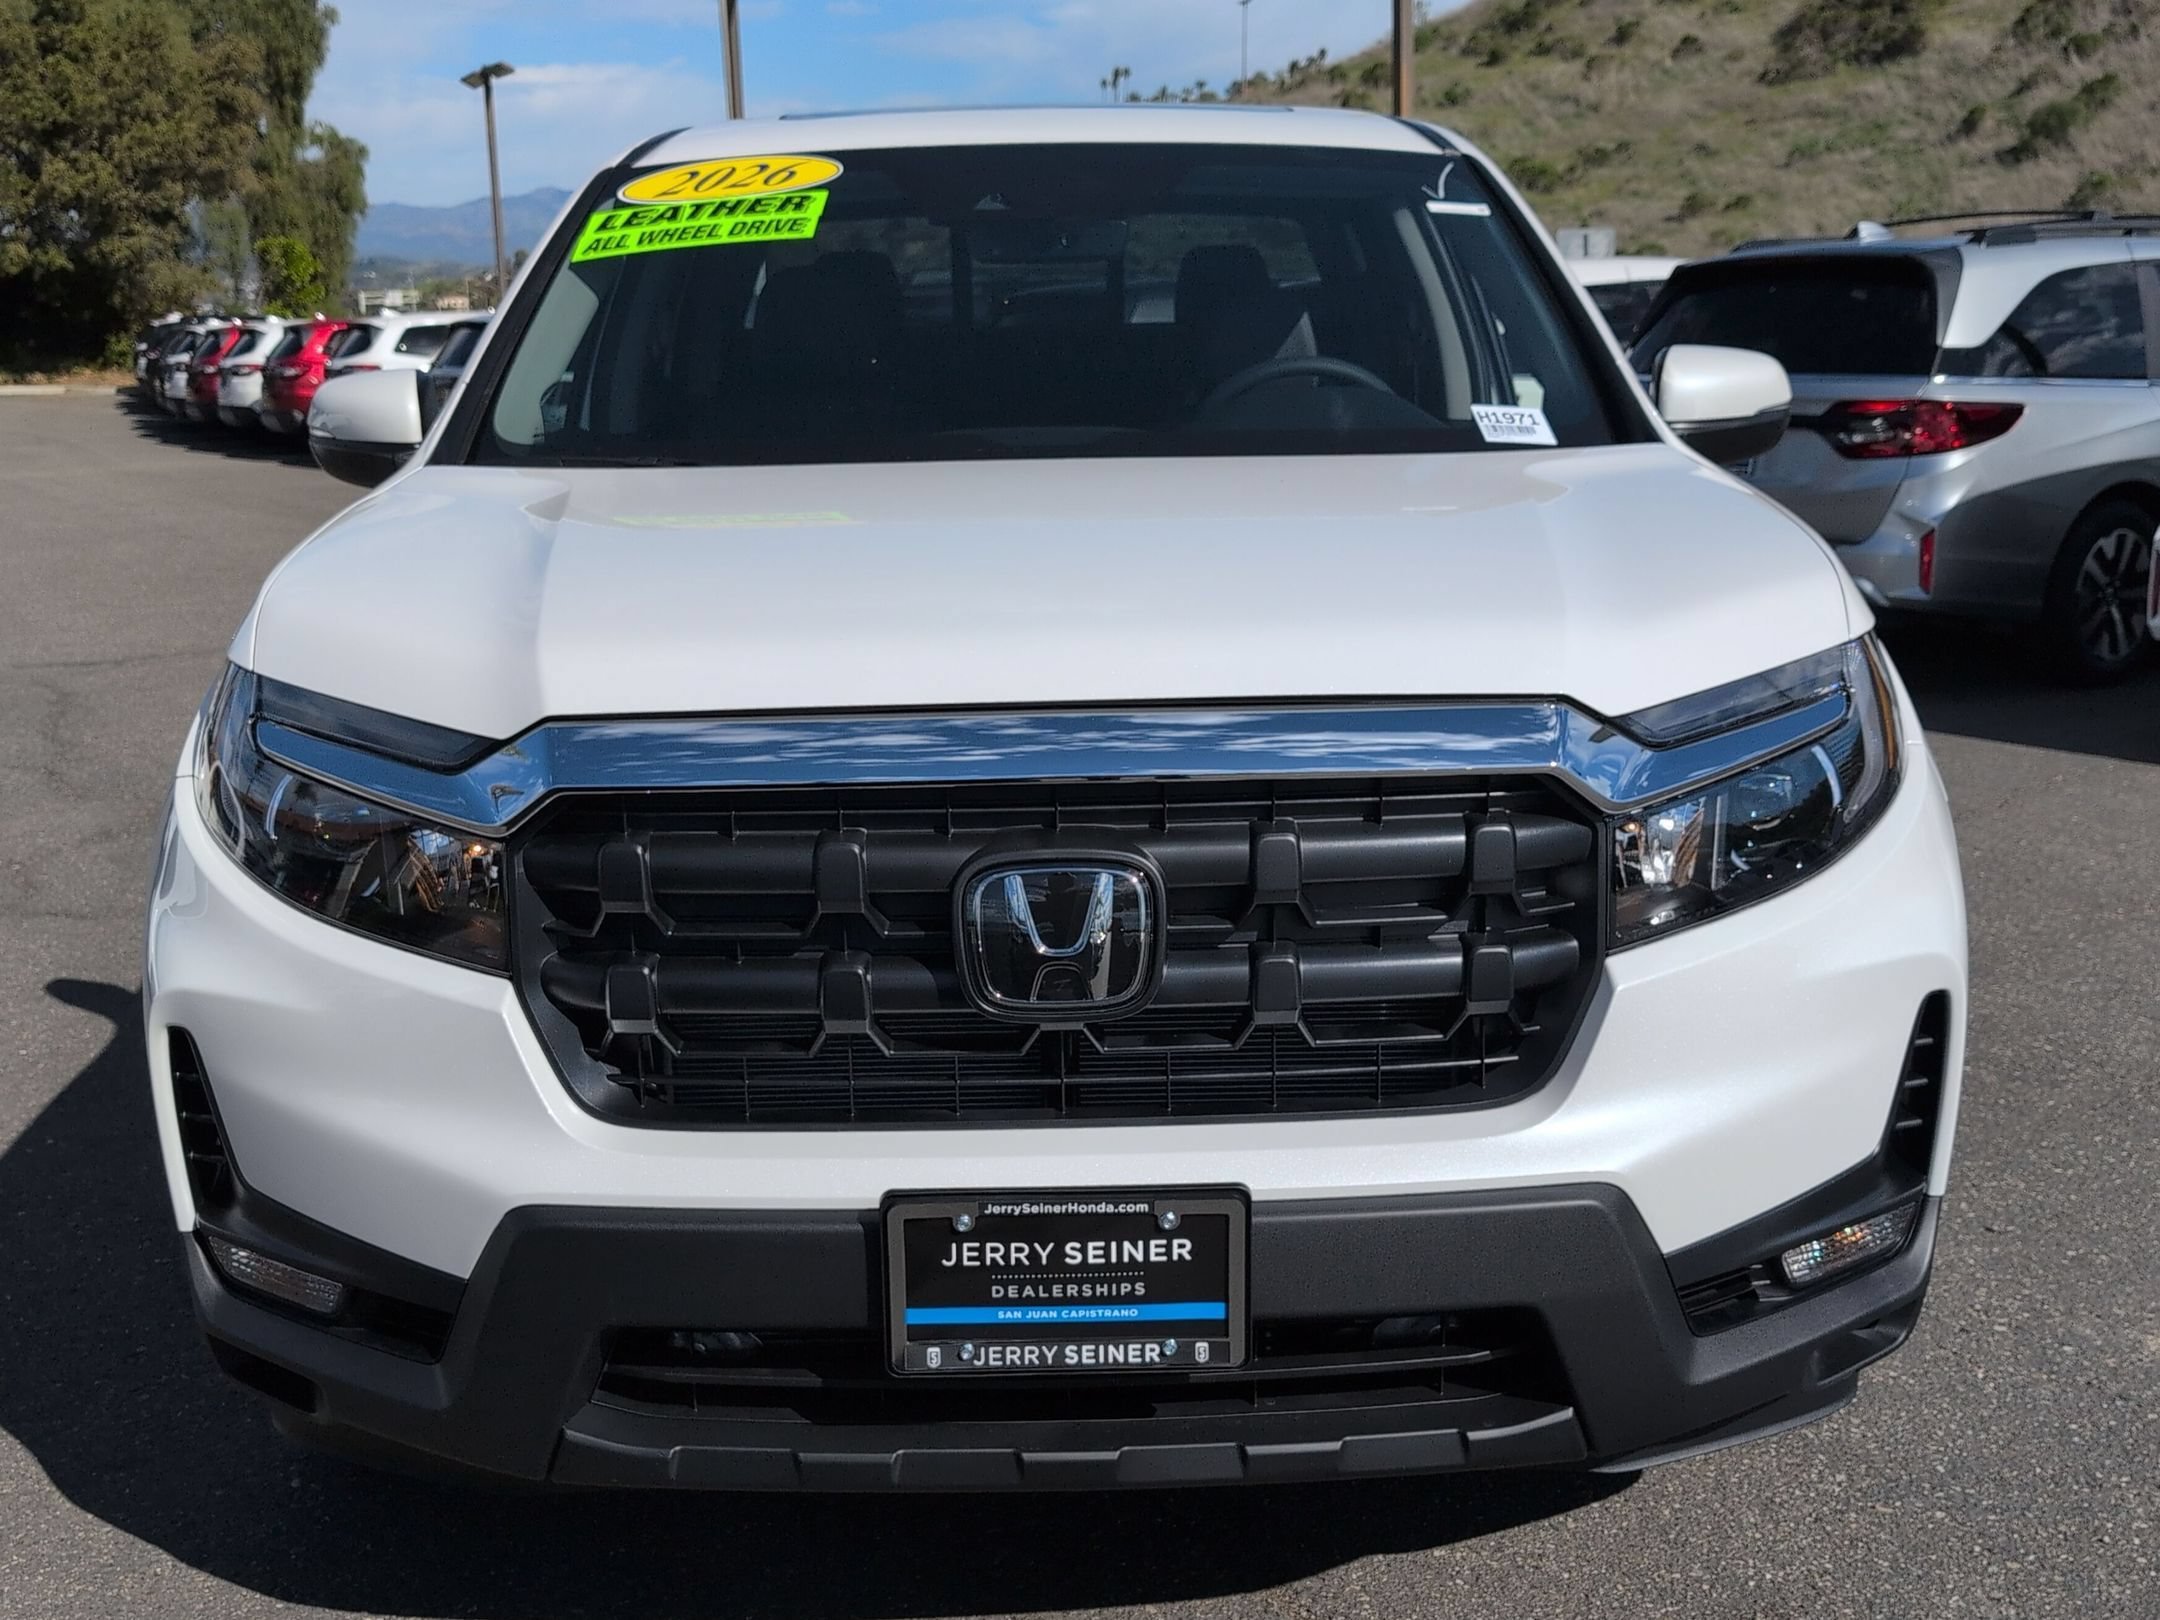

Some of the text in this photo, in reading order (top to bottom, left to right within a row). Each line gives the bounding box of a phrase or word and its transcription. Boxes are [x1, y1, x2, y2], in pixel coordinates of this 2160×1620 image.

[654, 159, 812, 198] 2026
[594, 195, 815, 234] LEATHER
[582, 217, 807, 255] ALL WHEEL DRIVE
[1476, 411, 1540, 426] H1971
[984, 1202, 1149, 1216] JerrySeinerHonda.com
[941, 1238, 1193, 1267] JERRY SEINER
[991, 1282, 1147, 1299] DEALERSHIPS
[997, 1308, 1139, 1319] SAN JUAN CAPISTRANO
[973, 1343, 1161, 1366] JERRY SEINER
